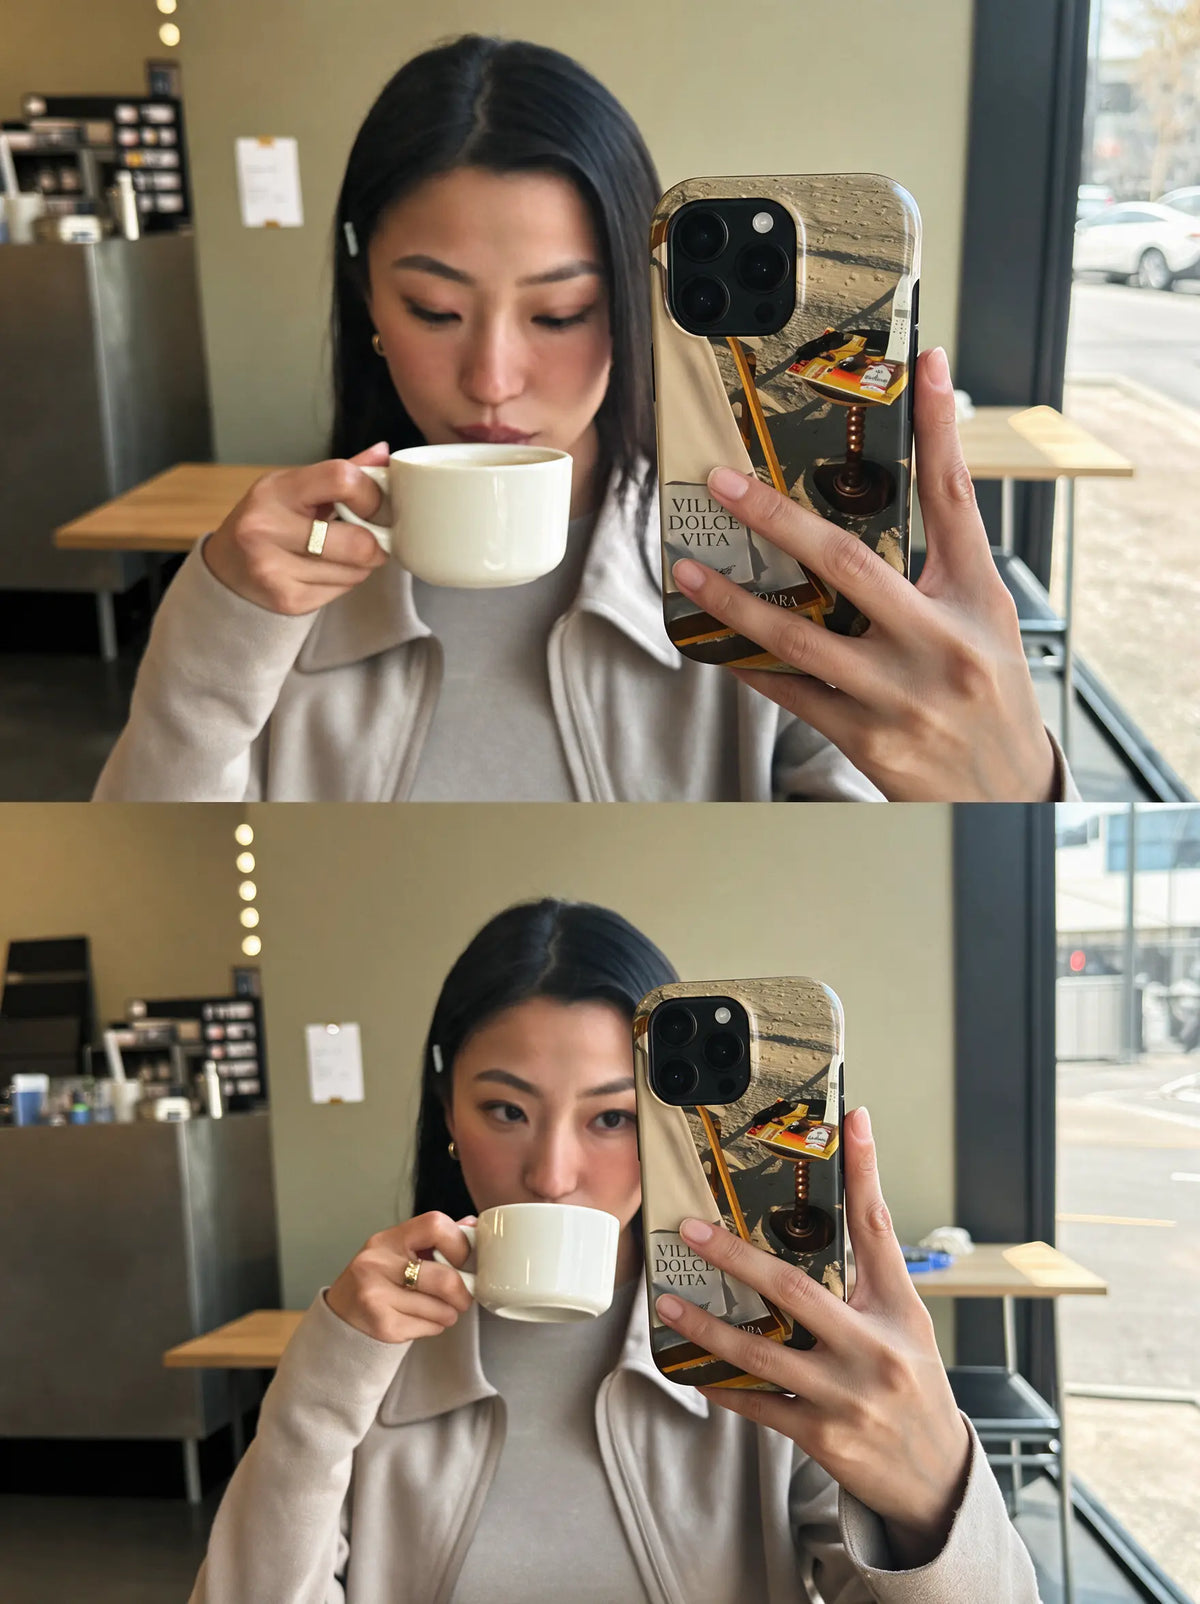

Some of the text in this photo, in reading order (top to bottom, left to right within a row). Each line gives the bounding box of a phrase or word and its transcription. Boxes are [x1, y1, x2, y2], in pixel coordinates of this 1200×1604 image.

[668, 515, 740, 530] DOLCE
[681, 532, 730, 546] VITA
[657, 1244, 699, 1257] VILL
[666, 1274, 707, 1286] VITA
